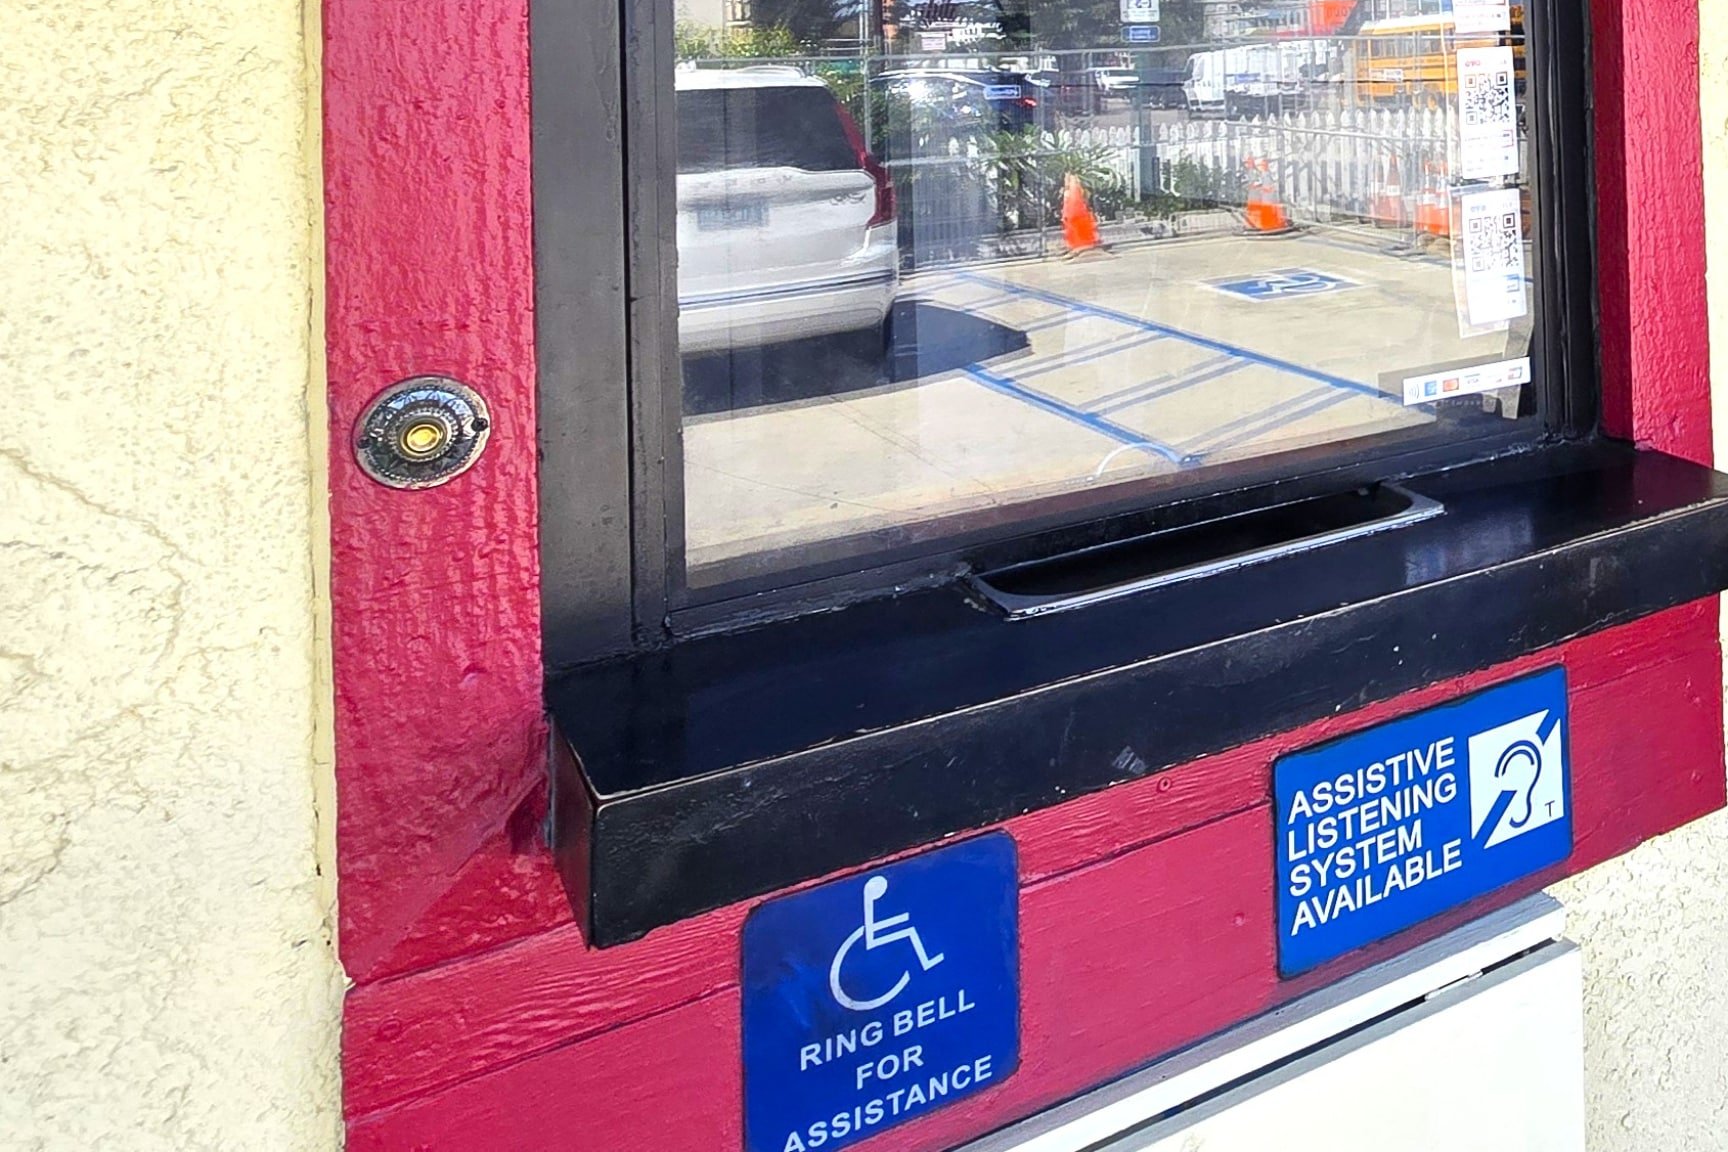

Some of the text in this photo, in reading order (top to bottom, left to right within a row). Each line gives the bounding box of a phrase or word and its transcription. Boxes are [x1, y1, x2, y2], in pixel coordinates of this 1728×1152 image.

[1287, 736, 1456, 825] ASSISTIVE
[1287, 772, 1458, 862] LISTENING
[1544, 799, 1556, 818] T
[1289, 828, 1423, 897] SYSTEM
[1291, 837, 1463, 936] AVAILABLE
[800, 988, 976, 1072] RING BELL
[856, 1045, 924, 1090] FOR
[783, 1054, 993, 1152] ASSISTANCE
